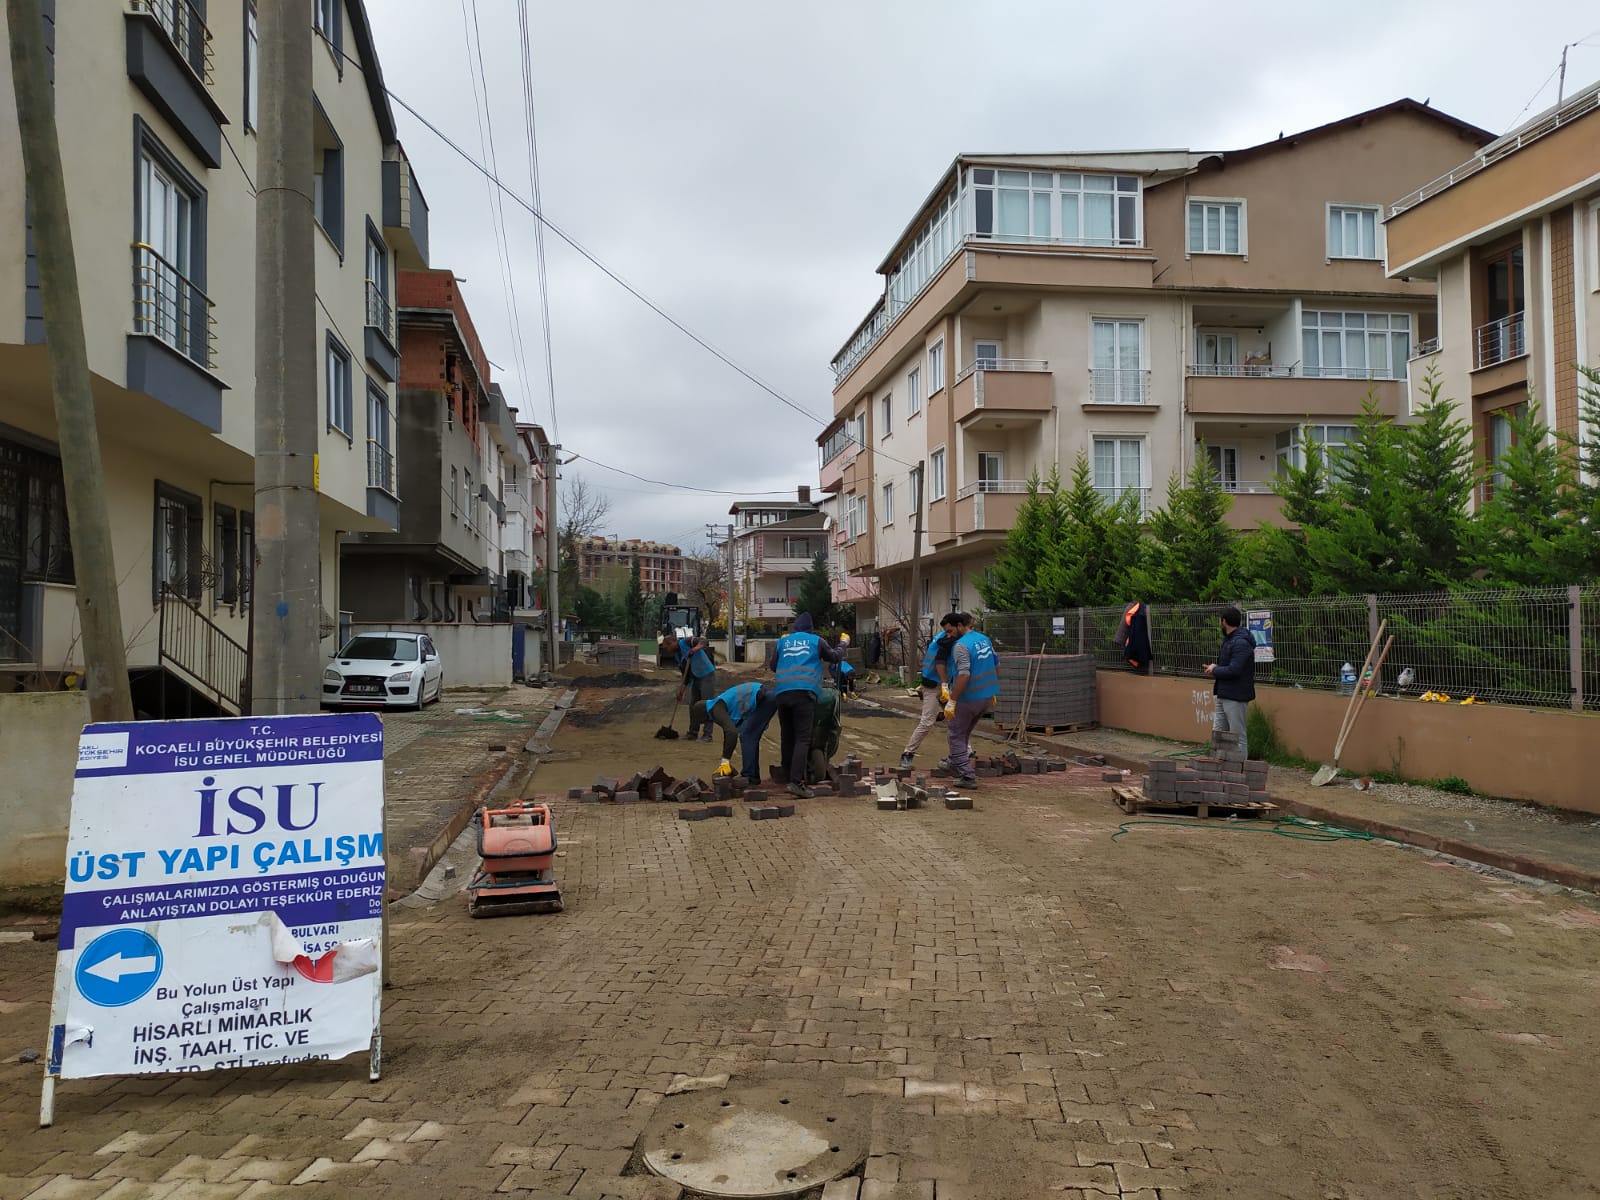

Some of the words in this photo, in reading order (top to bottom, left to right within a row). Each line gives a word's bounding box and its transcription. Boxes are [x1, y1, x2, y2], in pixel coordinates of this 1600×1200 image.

[250, 725, 276, 736] T.C.
[135, 740, 201, 756] KOCAELİ
[205, 737, 298, 752] BÜYÜKŞEHİR
[302, 731, 383, 747] BELEDİYESİ
[174, 755, 199, 767] İSU
[203, 754, 252, 766] GENEL
[256, 746, 346, 763] MÜDÜRLÜĞÜ
[192, 776, 326, 838] İSU
[70, 850, 145, 883] ÜST
[158, 845, 240, 875] YAPI
[253, 833, 384, 874] ÇALIŞM
[102, 884, 239, 909] ÇALIŞMALARIMIZDA
[242, 876, 319, 894] GÖSTERMİŞ
[323, 871, 385, 887] OLDUĞUN
[120, 902, 206, 920] ANLAYIŞTAN
[210, 896, 259, 912] DOLAYI
[263, 889, 332, 908] TEŞEKKÜR
[336, 884, 382, 900] EDERİZ
[291, 924, 339, 939] BULVARI
[303, 941, 322, 953] İSA
[156, 987, 178, 1000] Bu
[183, 983, 227, 998] Yolun
[232, 977, 258, 992] Üst
[262, 976, 294, 991] Yapı
[182, 996, 269, 1018] Çalışmaları
[132, 1019, 212, 1043] HİSARLI
[218, 1007, 313, 1033] MİMARLIK
[134, 1046, 172, 1067] İNŞ.
[180, 1038, 237, 1060] TAAH.
[243, 1031, 278, 1051] TİC.
[285, 1029, 310, 1047] VE
